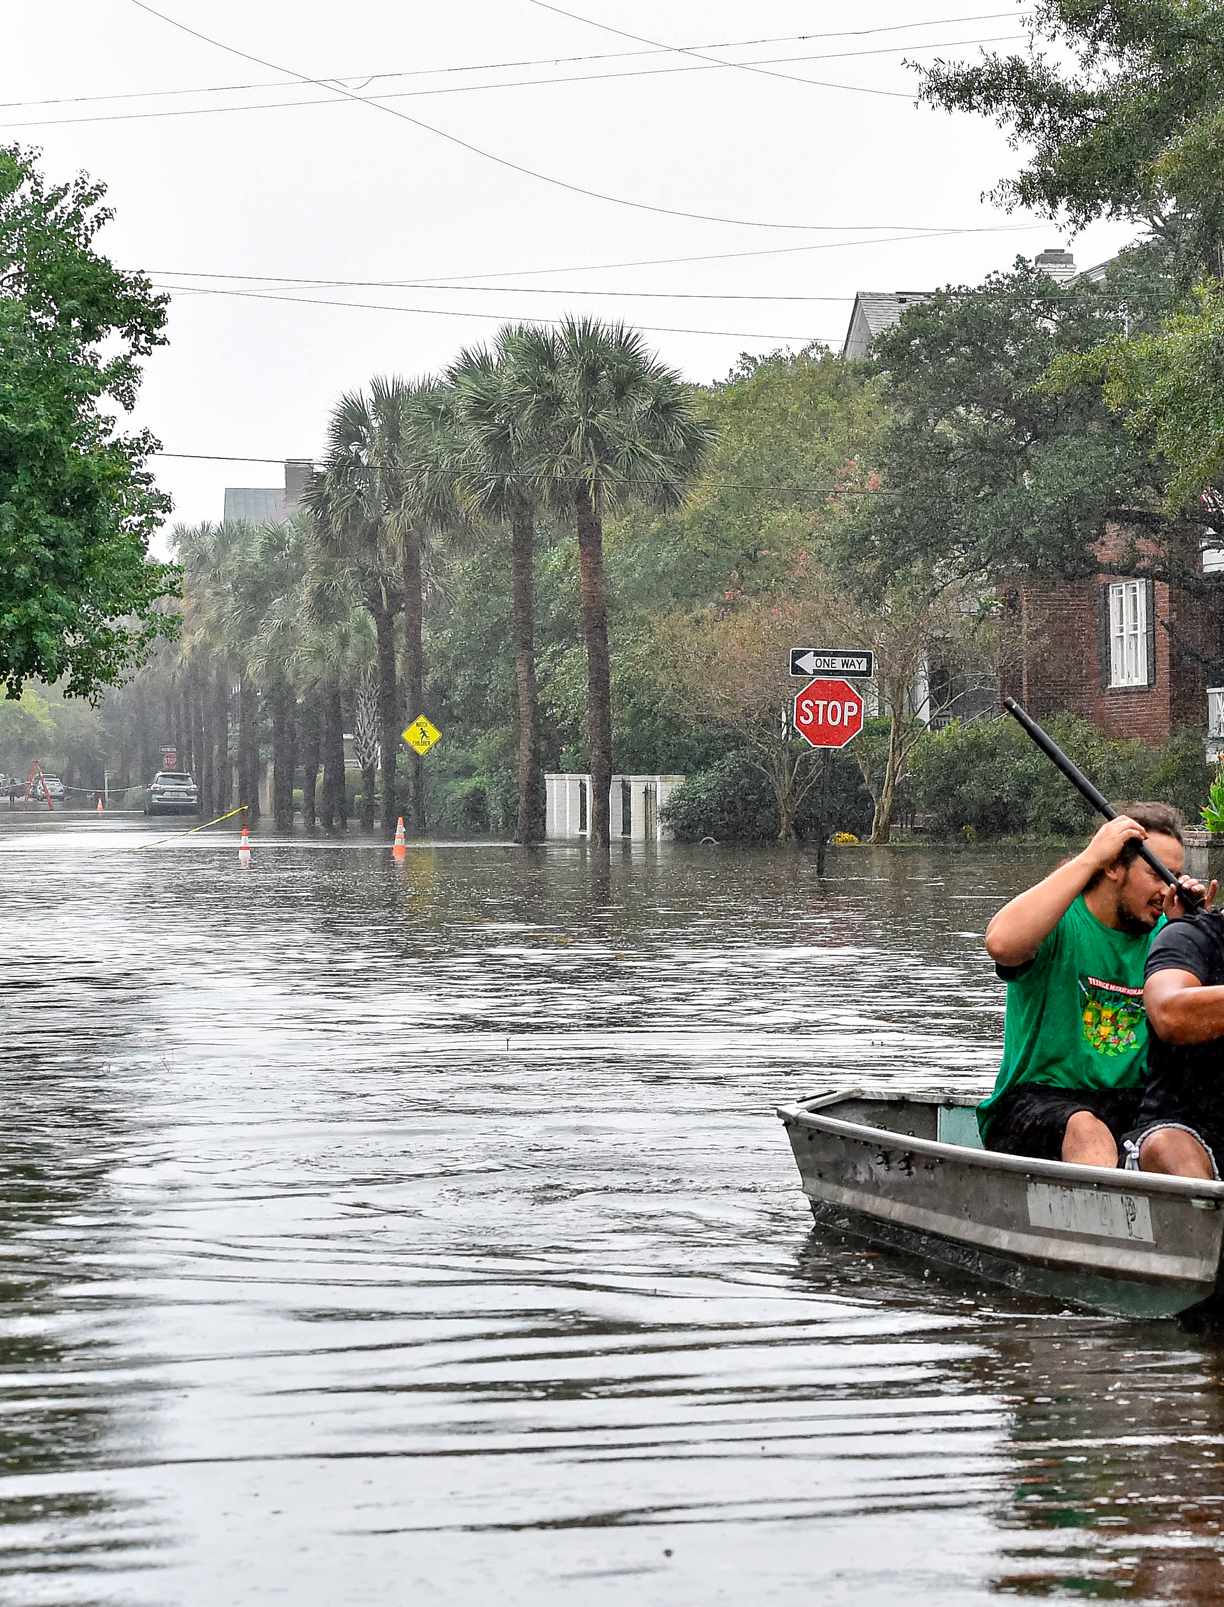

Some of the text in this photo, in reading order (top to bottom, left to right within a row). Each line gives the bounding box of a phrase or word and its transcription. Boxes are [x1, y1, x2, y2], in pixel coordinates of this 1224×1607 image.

[815, 658, 864, 669] ONE WAY
[799, 699, 858, 726] STOP
